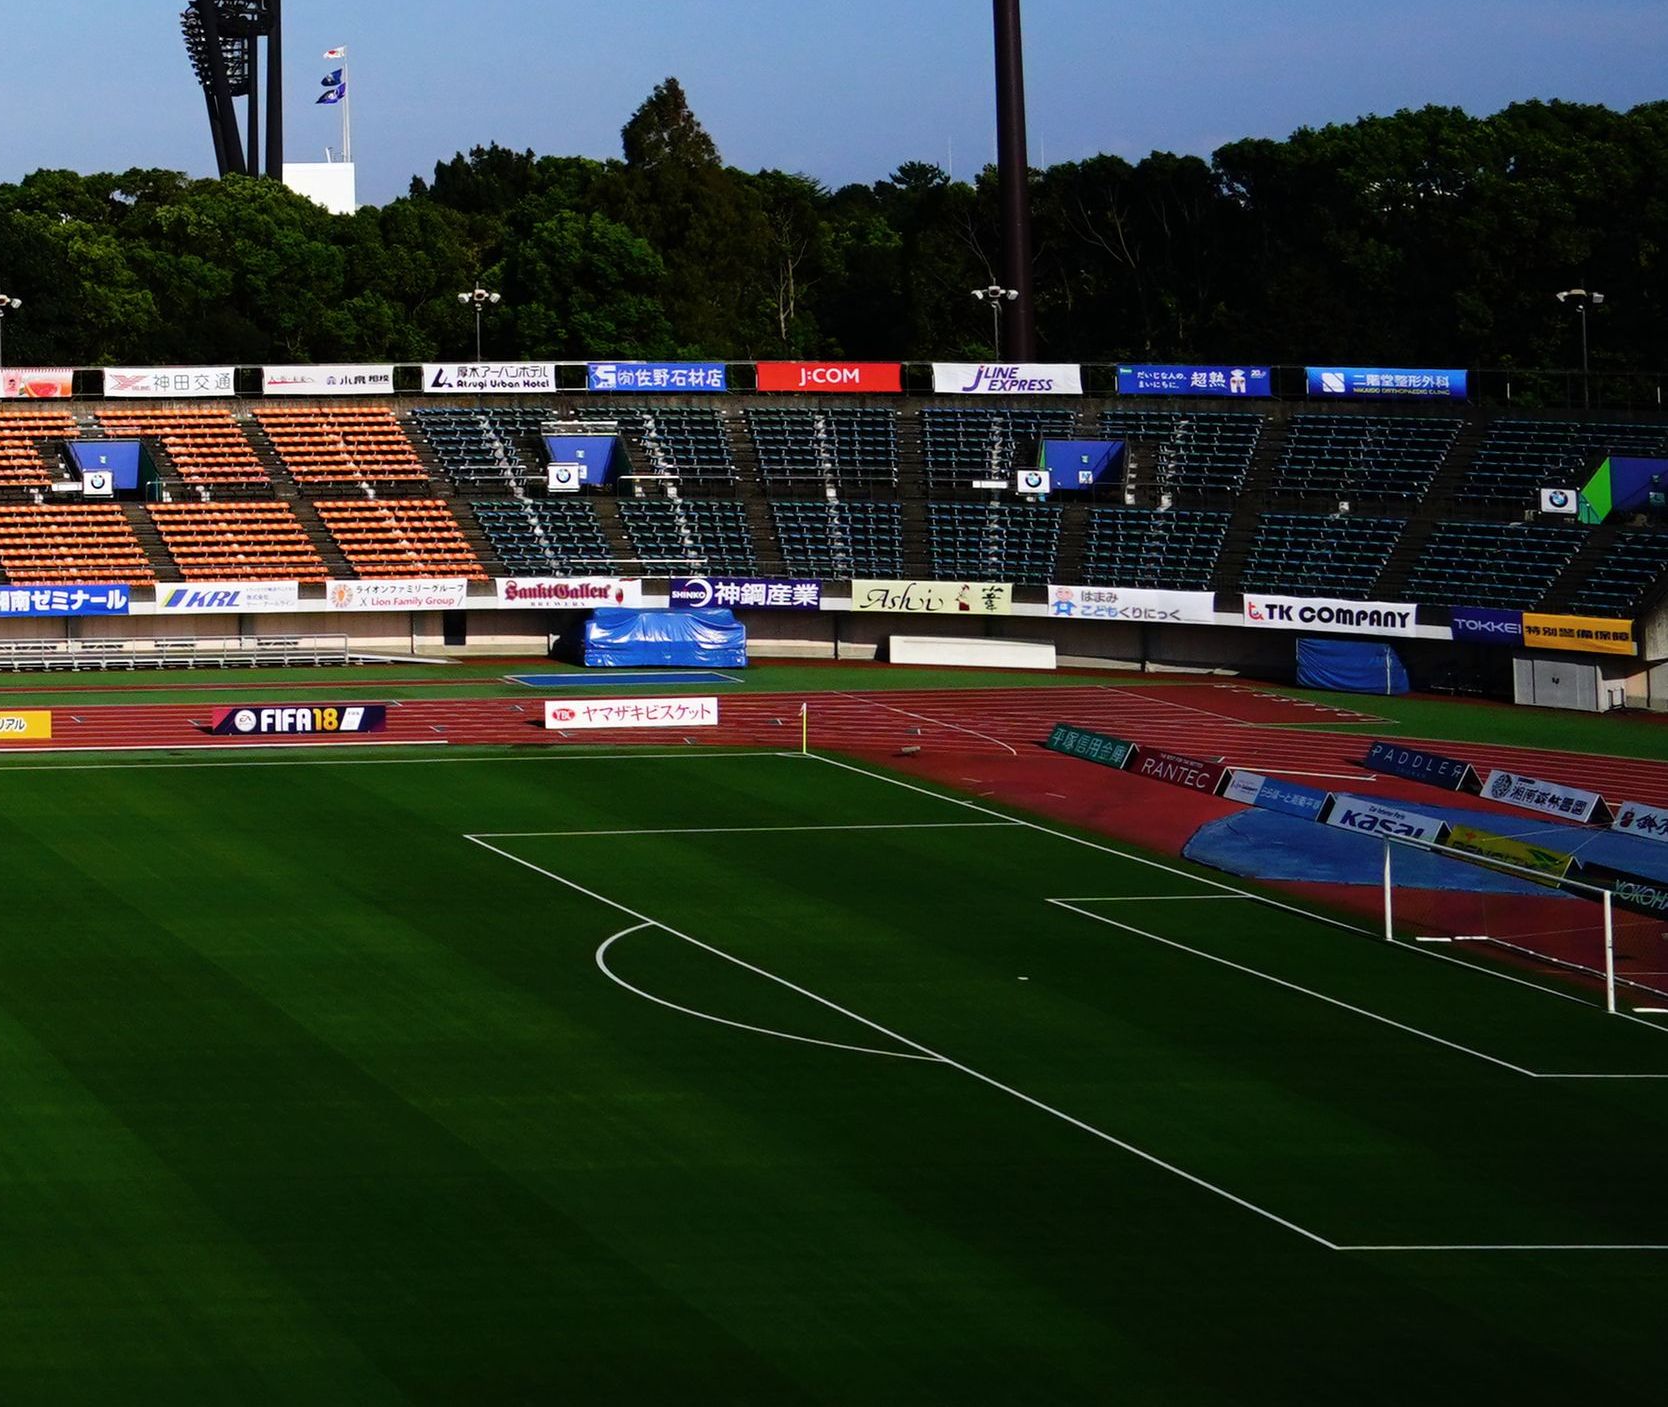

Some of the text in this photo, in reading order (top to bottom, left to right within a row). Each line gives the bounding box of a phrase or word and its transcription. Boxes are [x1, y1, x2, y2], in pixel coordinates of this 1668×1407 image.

[456, 366, 549, 378] 厚木アーバンホテル
[799, 367, 860, 386] J:COM
[153, 373, 231, 391] 神田交通
[456, 379, 549, 390] Atsugi Urban Hotel
[989, 379, 1053, 391] EXPRESS
[1191, 371, 1226, 390] 超熟
[1353, 375, 1450, 388] 二階堂整形外科
[356, 583, 464, 594] ライオンファミリーグループ
[672, 582, 819, 606] SHINKO 神鋼産業
[185, 590, 241, 607] KRL
[371, 596, 455, 607] Lion Family Group
[1080, 591, 1118, 603] はまみ
[1080, 605, 1181, 621] こどもくりにっく
[1265, 604, 1411, 628] TK COMPANY
[1453, 618, 1521, 634] TOKKEI
[583, 703, 711, 721] ヤマザキビスケット
[1141, 758, 1211, 789] RANTEC
